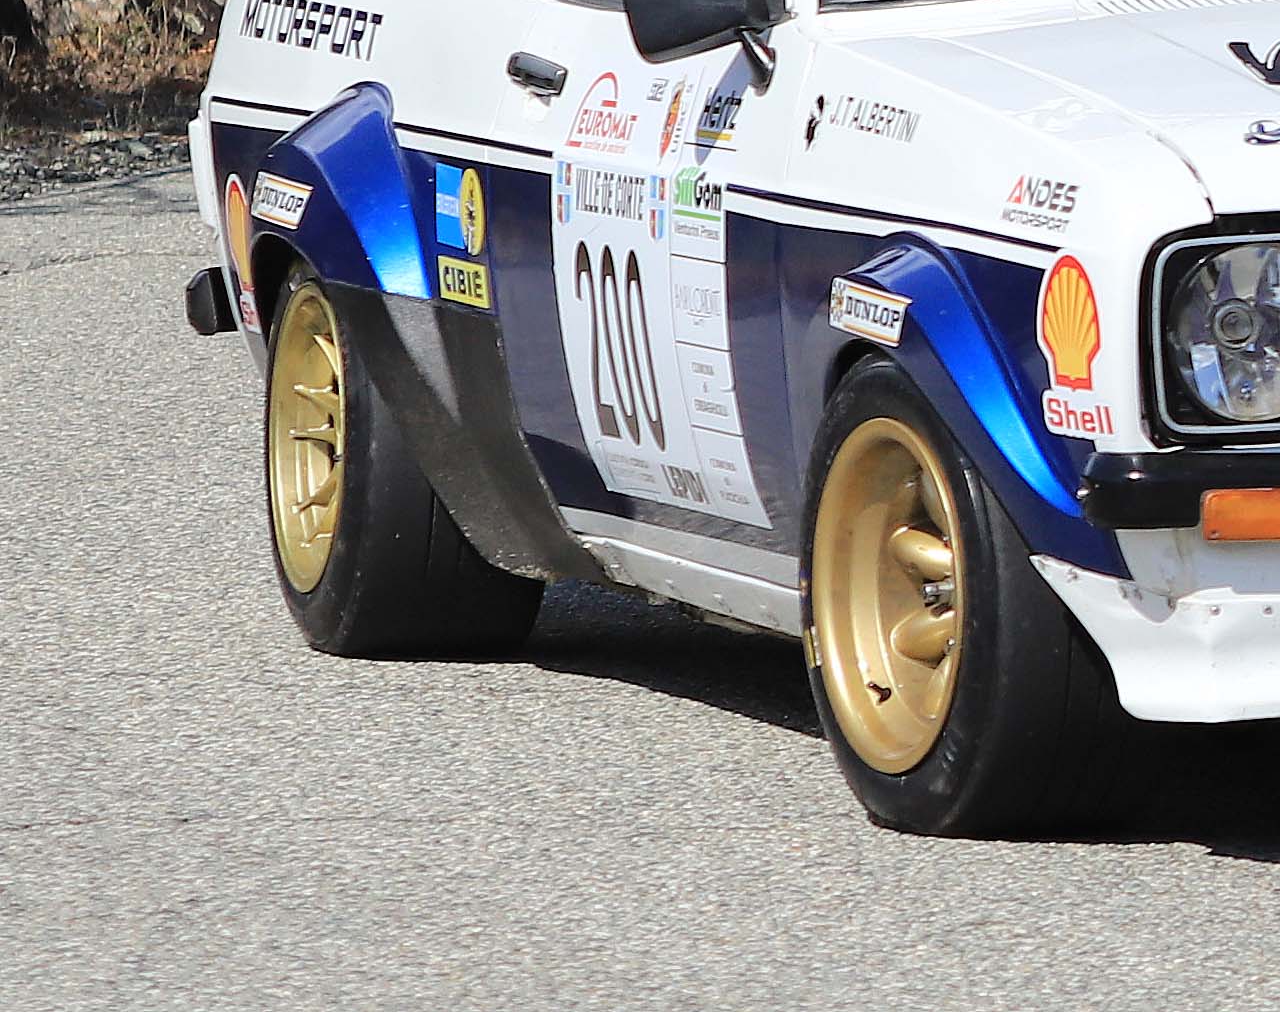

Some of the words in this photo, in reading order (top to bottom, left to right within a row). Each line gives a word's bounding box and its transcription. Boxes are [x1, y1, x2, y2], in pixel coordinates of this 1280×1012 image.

[576, 109, 639, 141] EUROMAT
[261, 186, 305, 214] DUNLOP
[576, 168, 601, 213] VILLE
[602, 172, 615, 215] DE
[615, 174, 645, 220] CORTE
[1007, 175, 1080, 213] ANDES
[1001, 208, 1070, 233] MOTORSPORT
[844, 296, 900, 329] DUNLOP
[575, 239, 666, 453] 200
[1046, 397, 1115, 435] Shell
